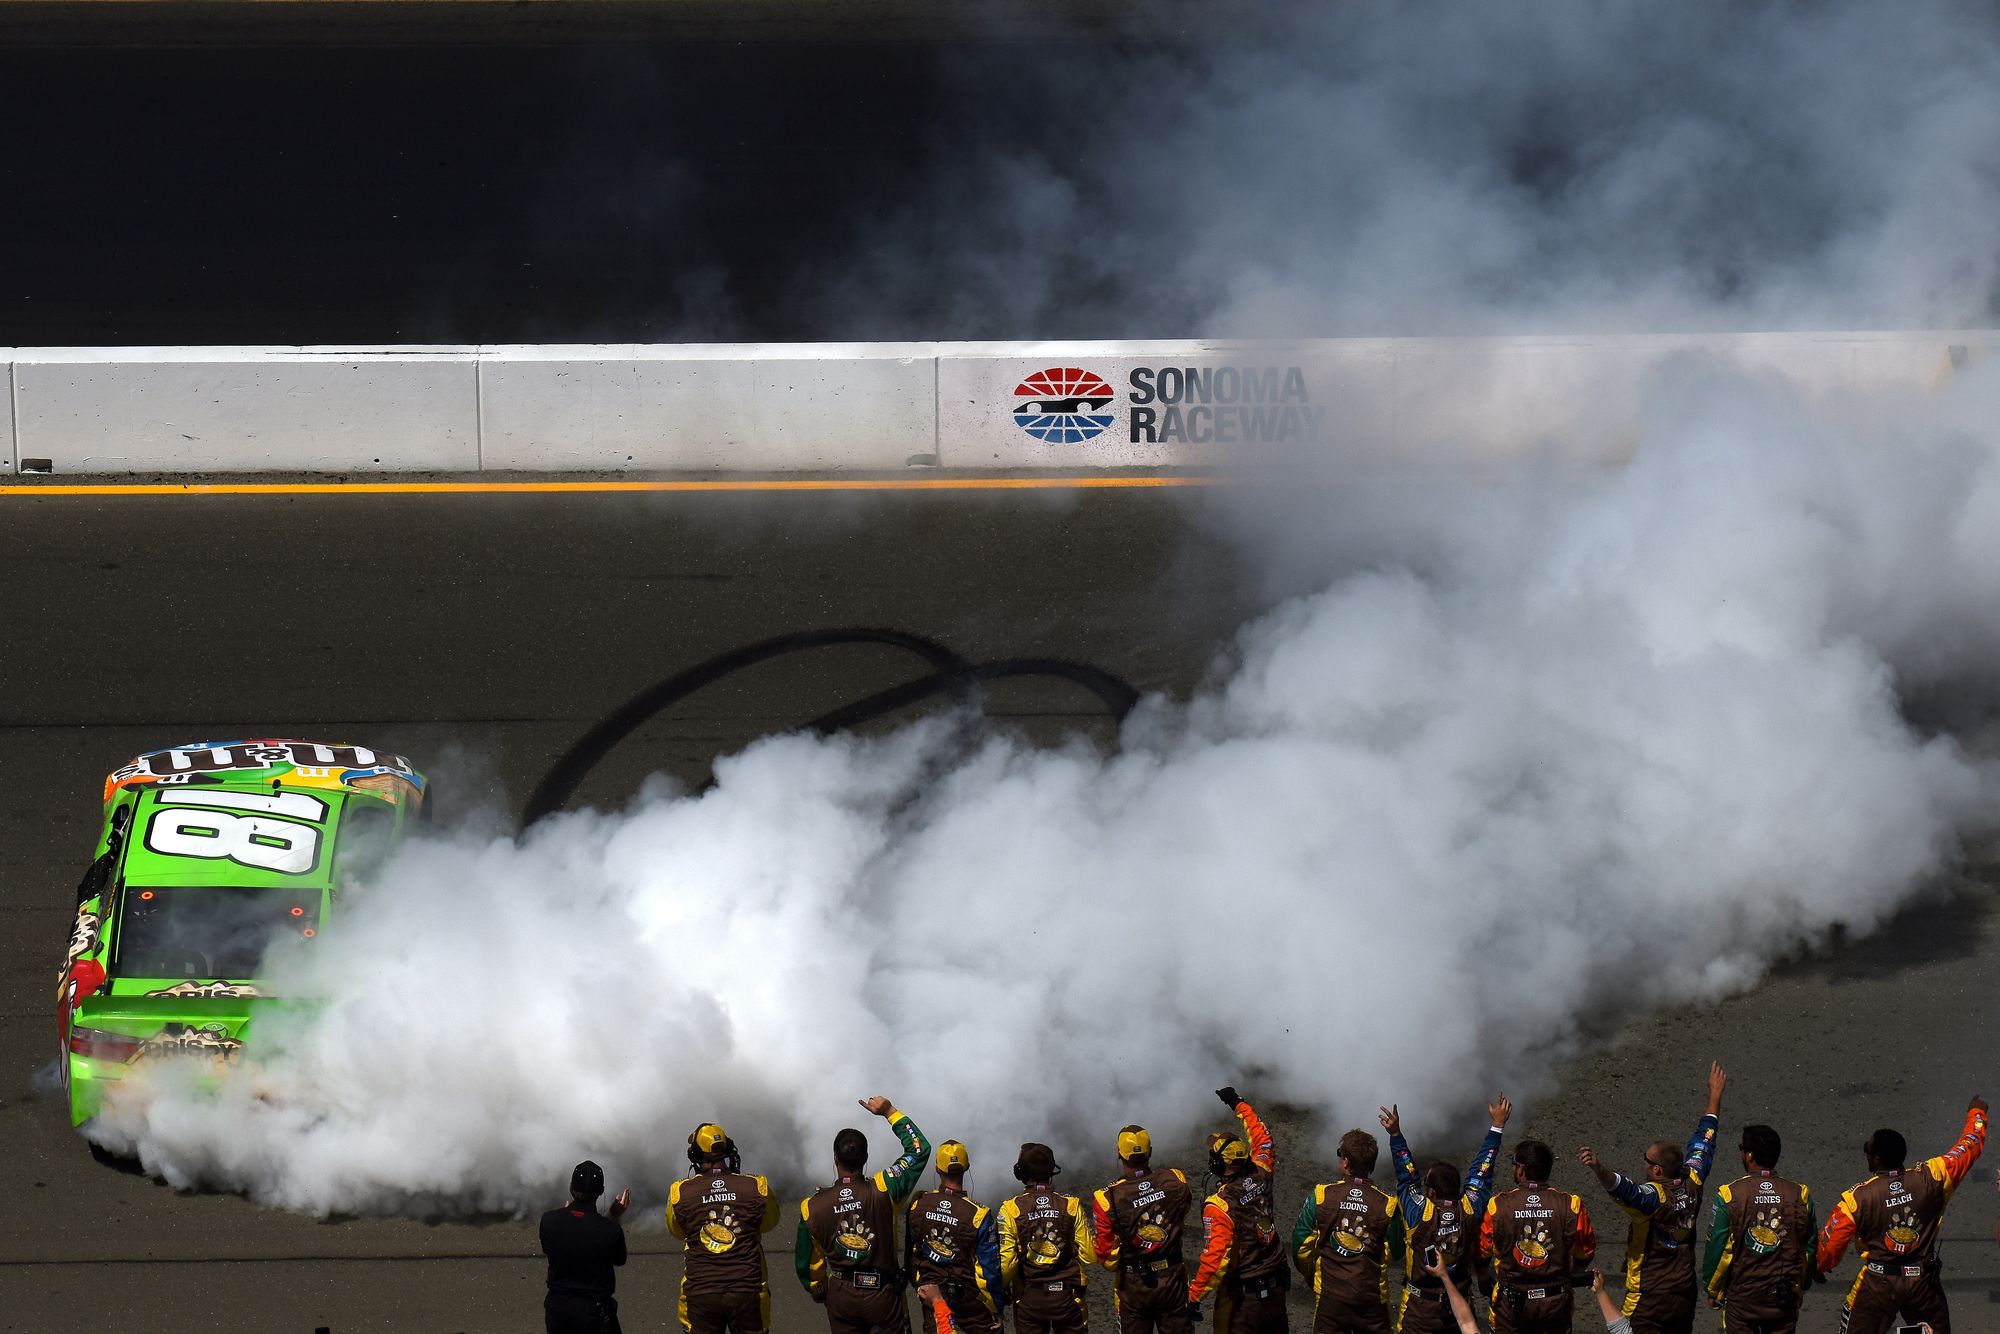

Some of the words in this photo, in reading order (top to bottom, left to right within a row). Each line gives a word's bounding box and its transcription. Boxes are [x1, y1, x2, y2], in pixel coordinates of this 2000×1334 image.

[1129, 367, 1307, 405] SONOMA
[1130, 407, 1325, 443] RACEWAY
[143, 788, 330, 876] 18
[702, 1192, 736, 1204] LANDIS
[1132, 1190, 1166, 1208] FENDER
[1754, 1196, 1781, 1204] JONES
[1885, 1193, 1914, 1208] LEACH
[833, 1201, 862, 1214] LAMPE
[1339, 1201, 1368, 1212] KOONS
[1514, 1210, 1554, 1218] DONAGHY
[925, 1211, 958, 1226] GREENE
